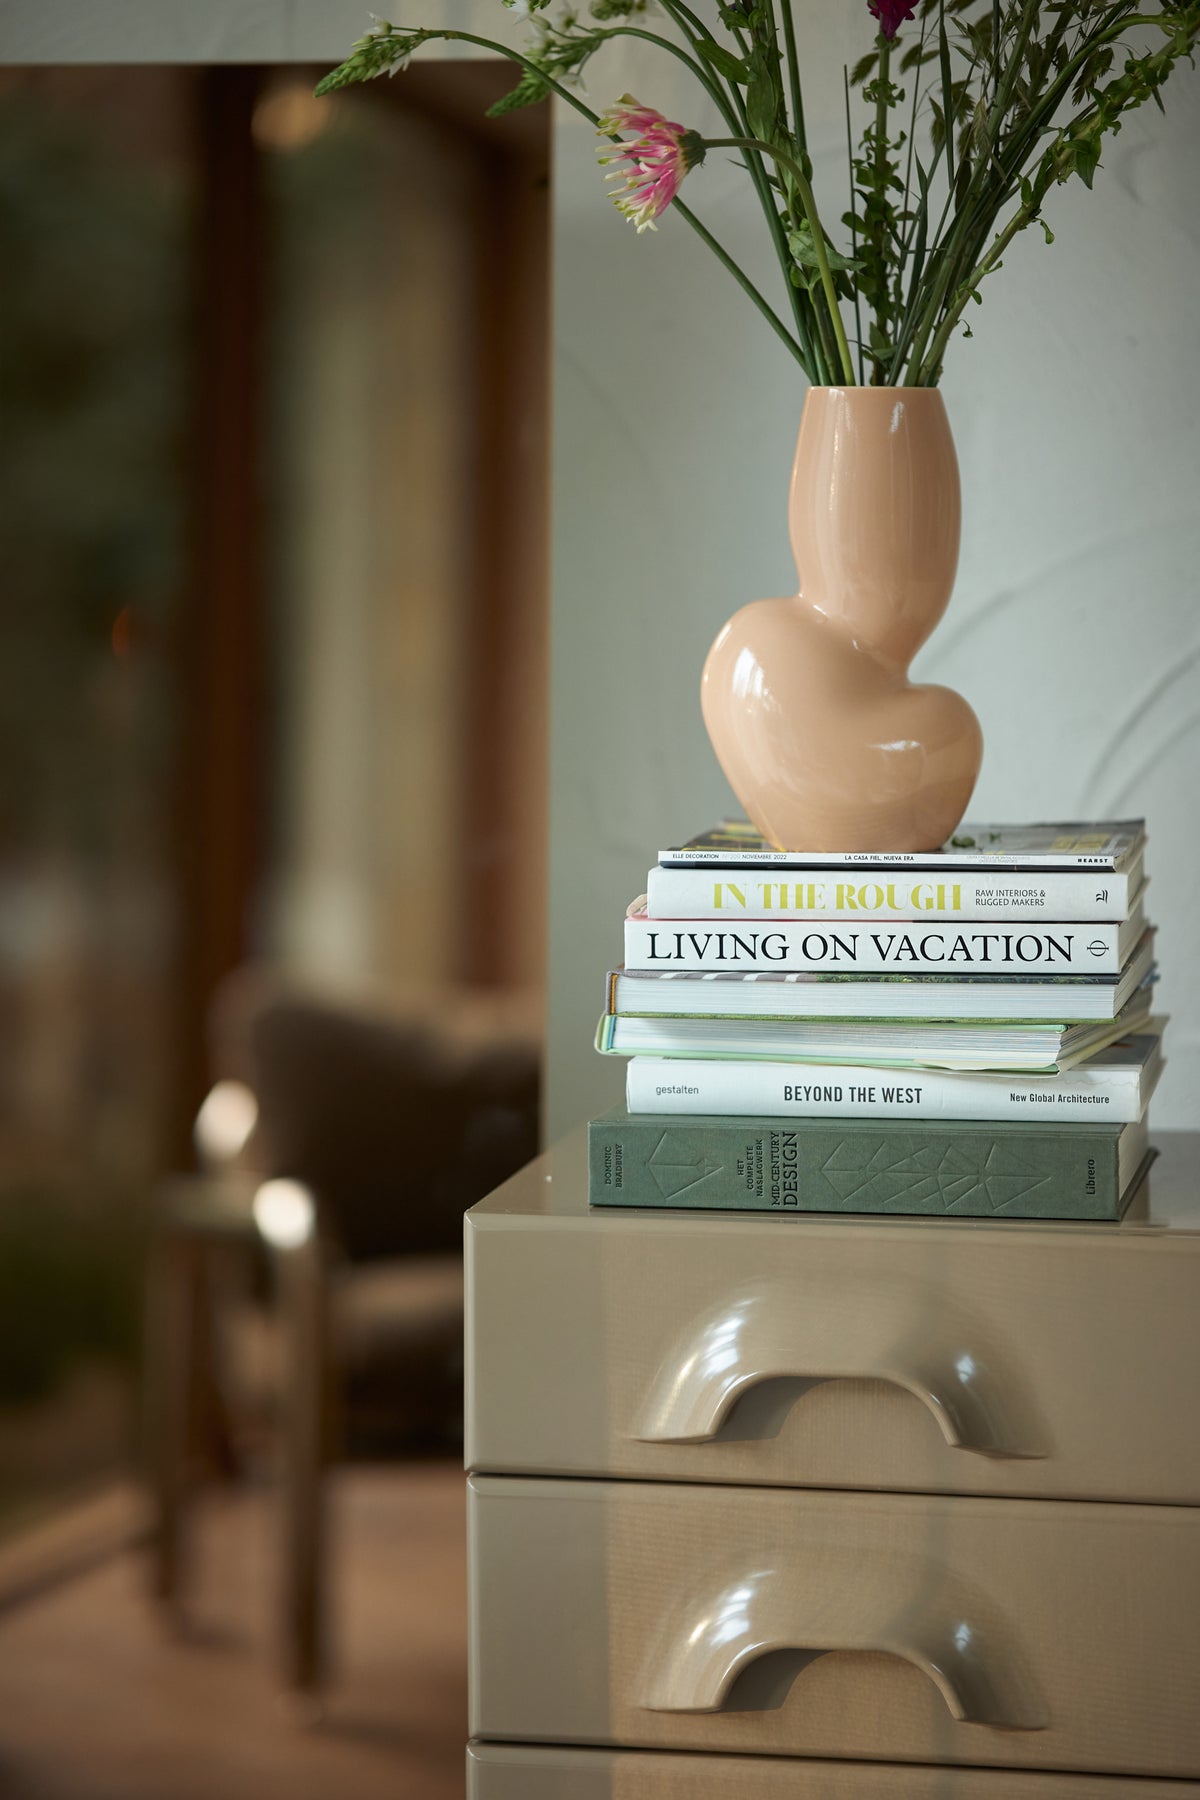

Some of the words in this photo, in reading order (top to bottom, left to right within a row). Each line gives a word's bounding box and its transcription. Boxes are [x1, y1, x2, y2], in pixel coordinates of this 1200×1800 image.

[714, 883, 747, 910] IN
[758, 883, 826, 910] THE
[836, 884, 962, 911] ROUGH
[647, 933, 790, 960] LIVING
[802, 934, 860, 960] ON
[870, 935, 1074, 962] VACATION
[656, 1085, 699, 1095] gestalten
[784, 1086, 842, 1102] BEYOND
[848, 1087, 876, 1102] THE
[882, 1088, 922, 1104] WEST
[1010, 1093, 1026, 1102] New
[1029, 1094, 1055, 1102] Global
[1058, 1094, 1110, 1104] Architecture
[782, 1132, 798, 1206] DESIGN
[1086, 1159, 1096, 1194] Librero
